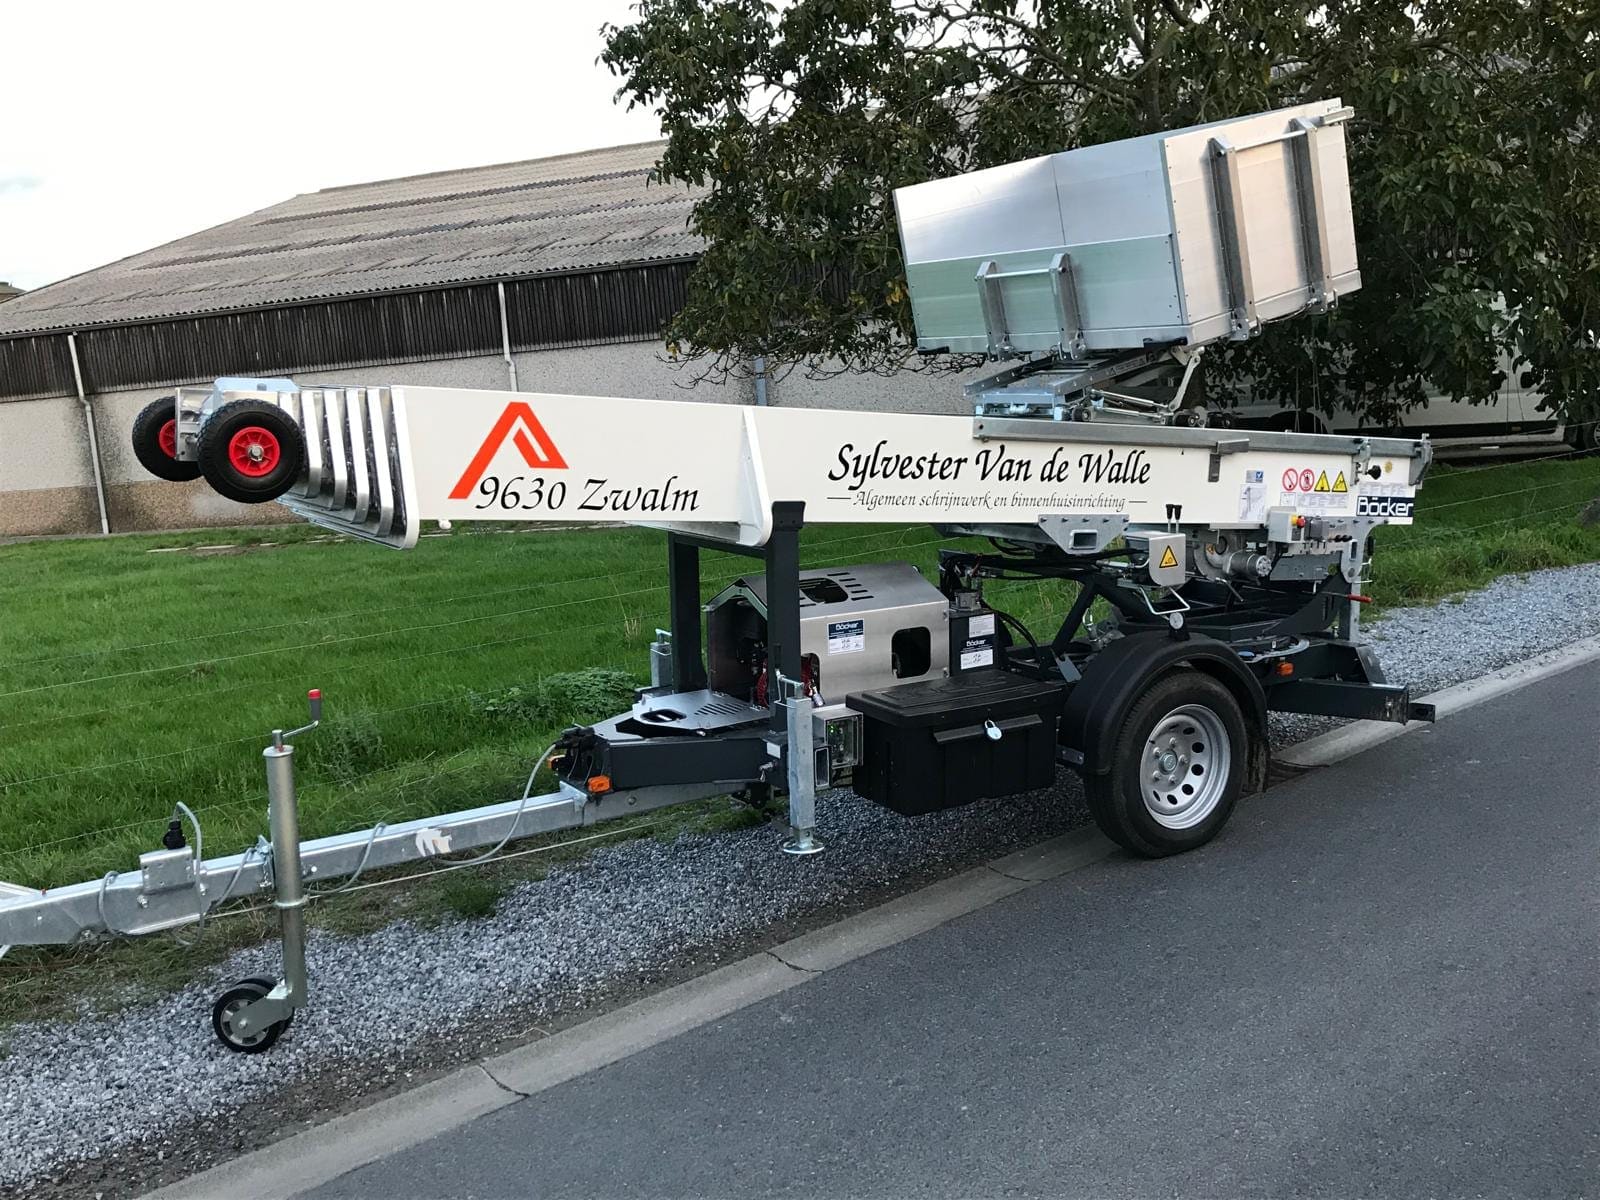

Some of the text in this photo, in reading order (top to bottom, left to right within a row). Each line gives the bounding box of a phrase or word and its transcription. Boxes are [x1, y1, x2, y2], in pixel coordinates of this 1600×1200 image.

[827, 440, 1151, 491] Sylvester Van de Walle
[475, 475, 700, 512] 9630 Zwalm
[853, 489, 1126, 512] Algemeen schrijnwerk en binnenhuisinrichting
[1357, 496, 1414, 517] Böcker
